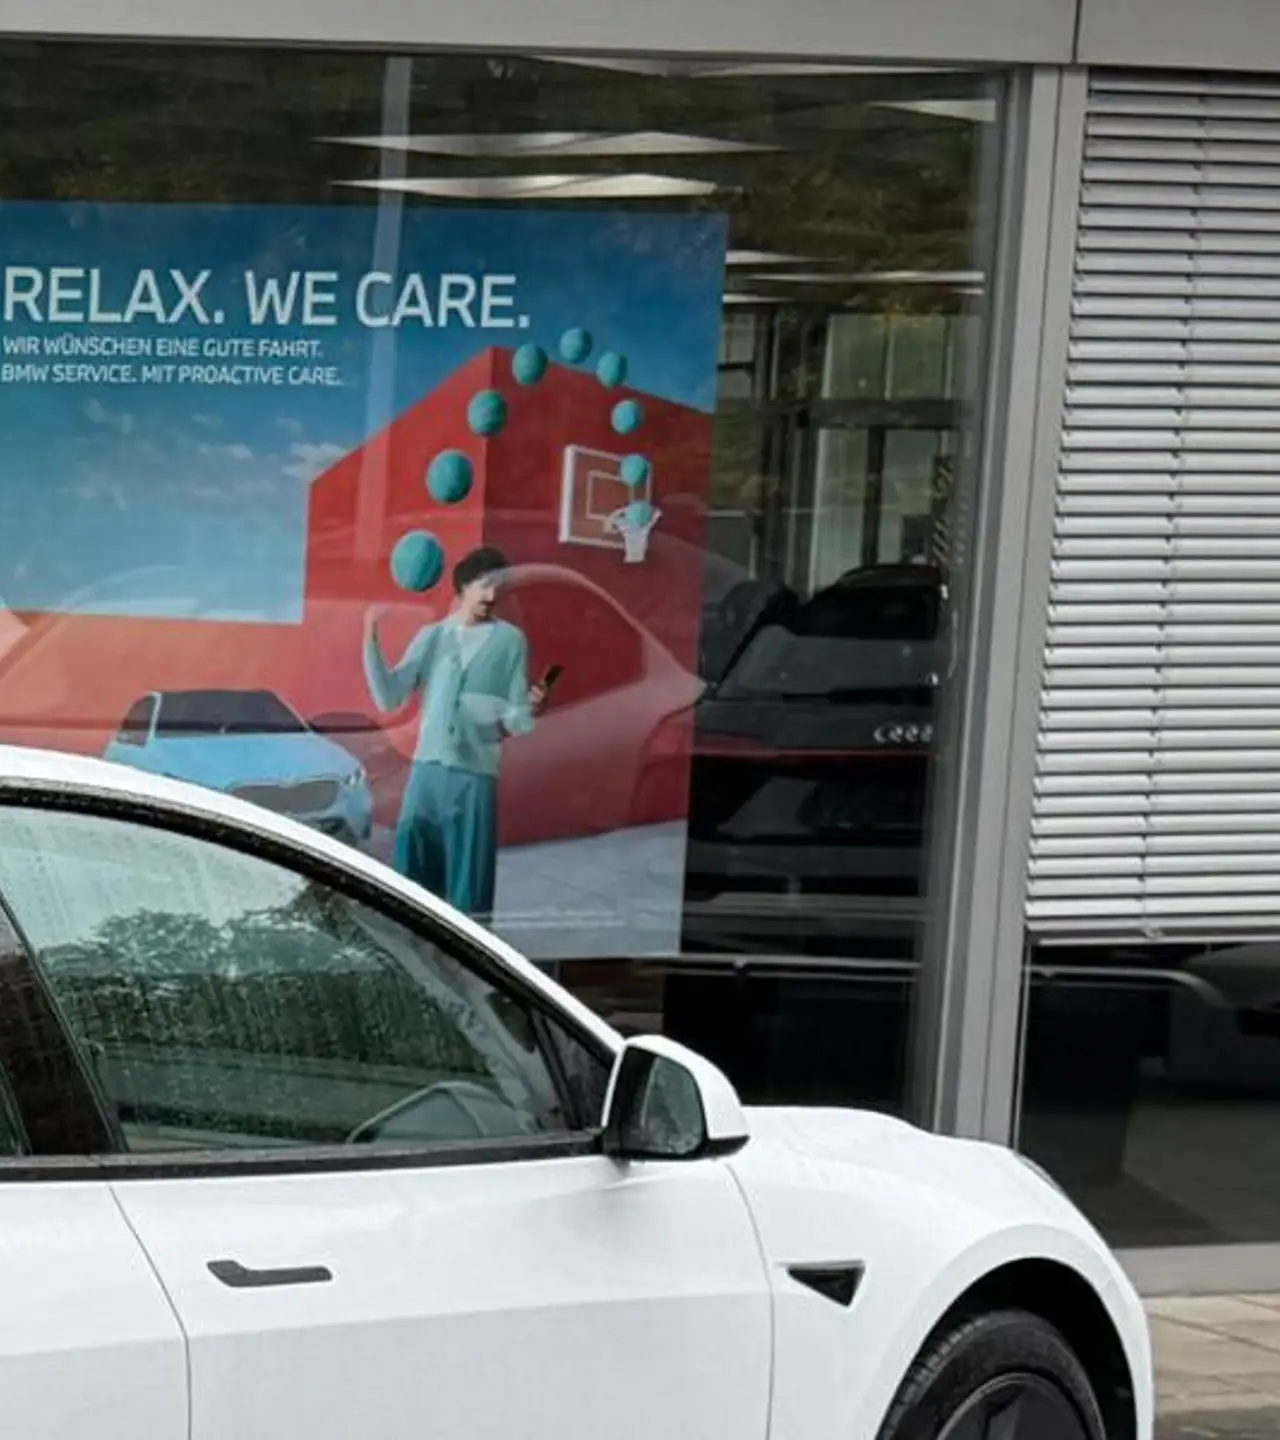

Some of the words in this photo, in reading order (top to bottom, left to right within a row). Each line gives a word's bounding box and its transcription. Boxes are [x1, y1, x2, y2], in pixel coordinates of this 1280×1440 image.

[3, 266, 225, 324] RELAX.
[244, 269, 338, 326] WE
[355, 271, 531, 328] CARE.
[2, 335, 40, 355] WIR
[43, 332, 152, 356] WÜNSCHEN
[156, 337, 200, 357] EINE
[203, 337, 255, 358] GUTE
[258, 338, 323, 359] FAHRT.
[0, 364, 50, 383] BMW
[51, 364, 138, 384] SERVICE.
[141, 365, 176, 384] MIT
[178, 365, 283, 385] PROACTIVE
[288, 366, 343, 386] CARE.
